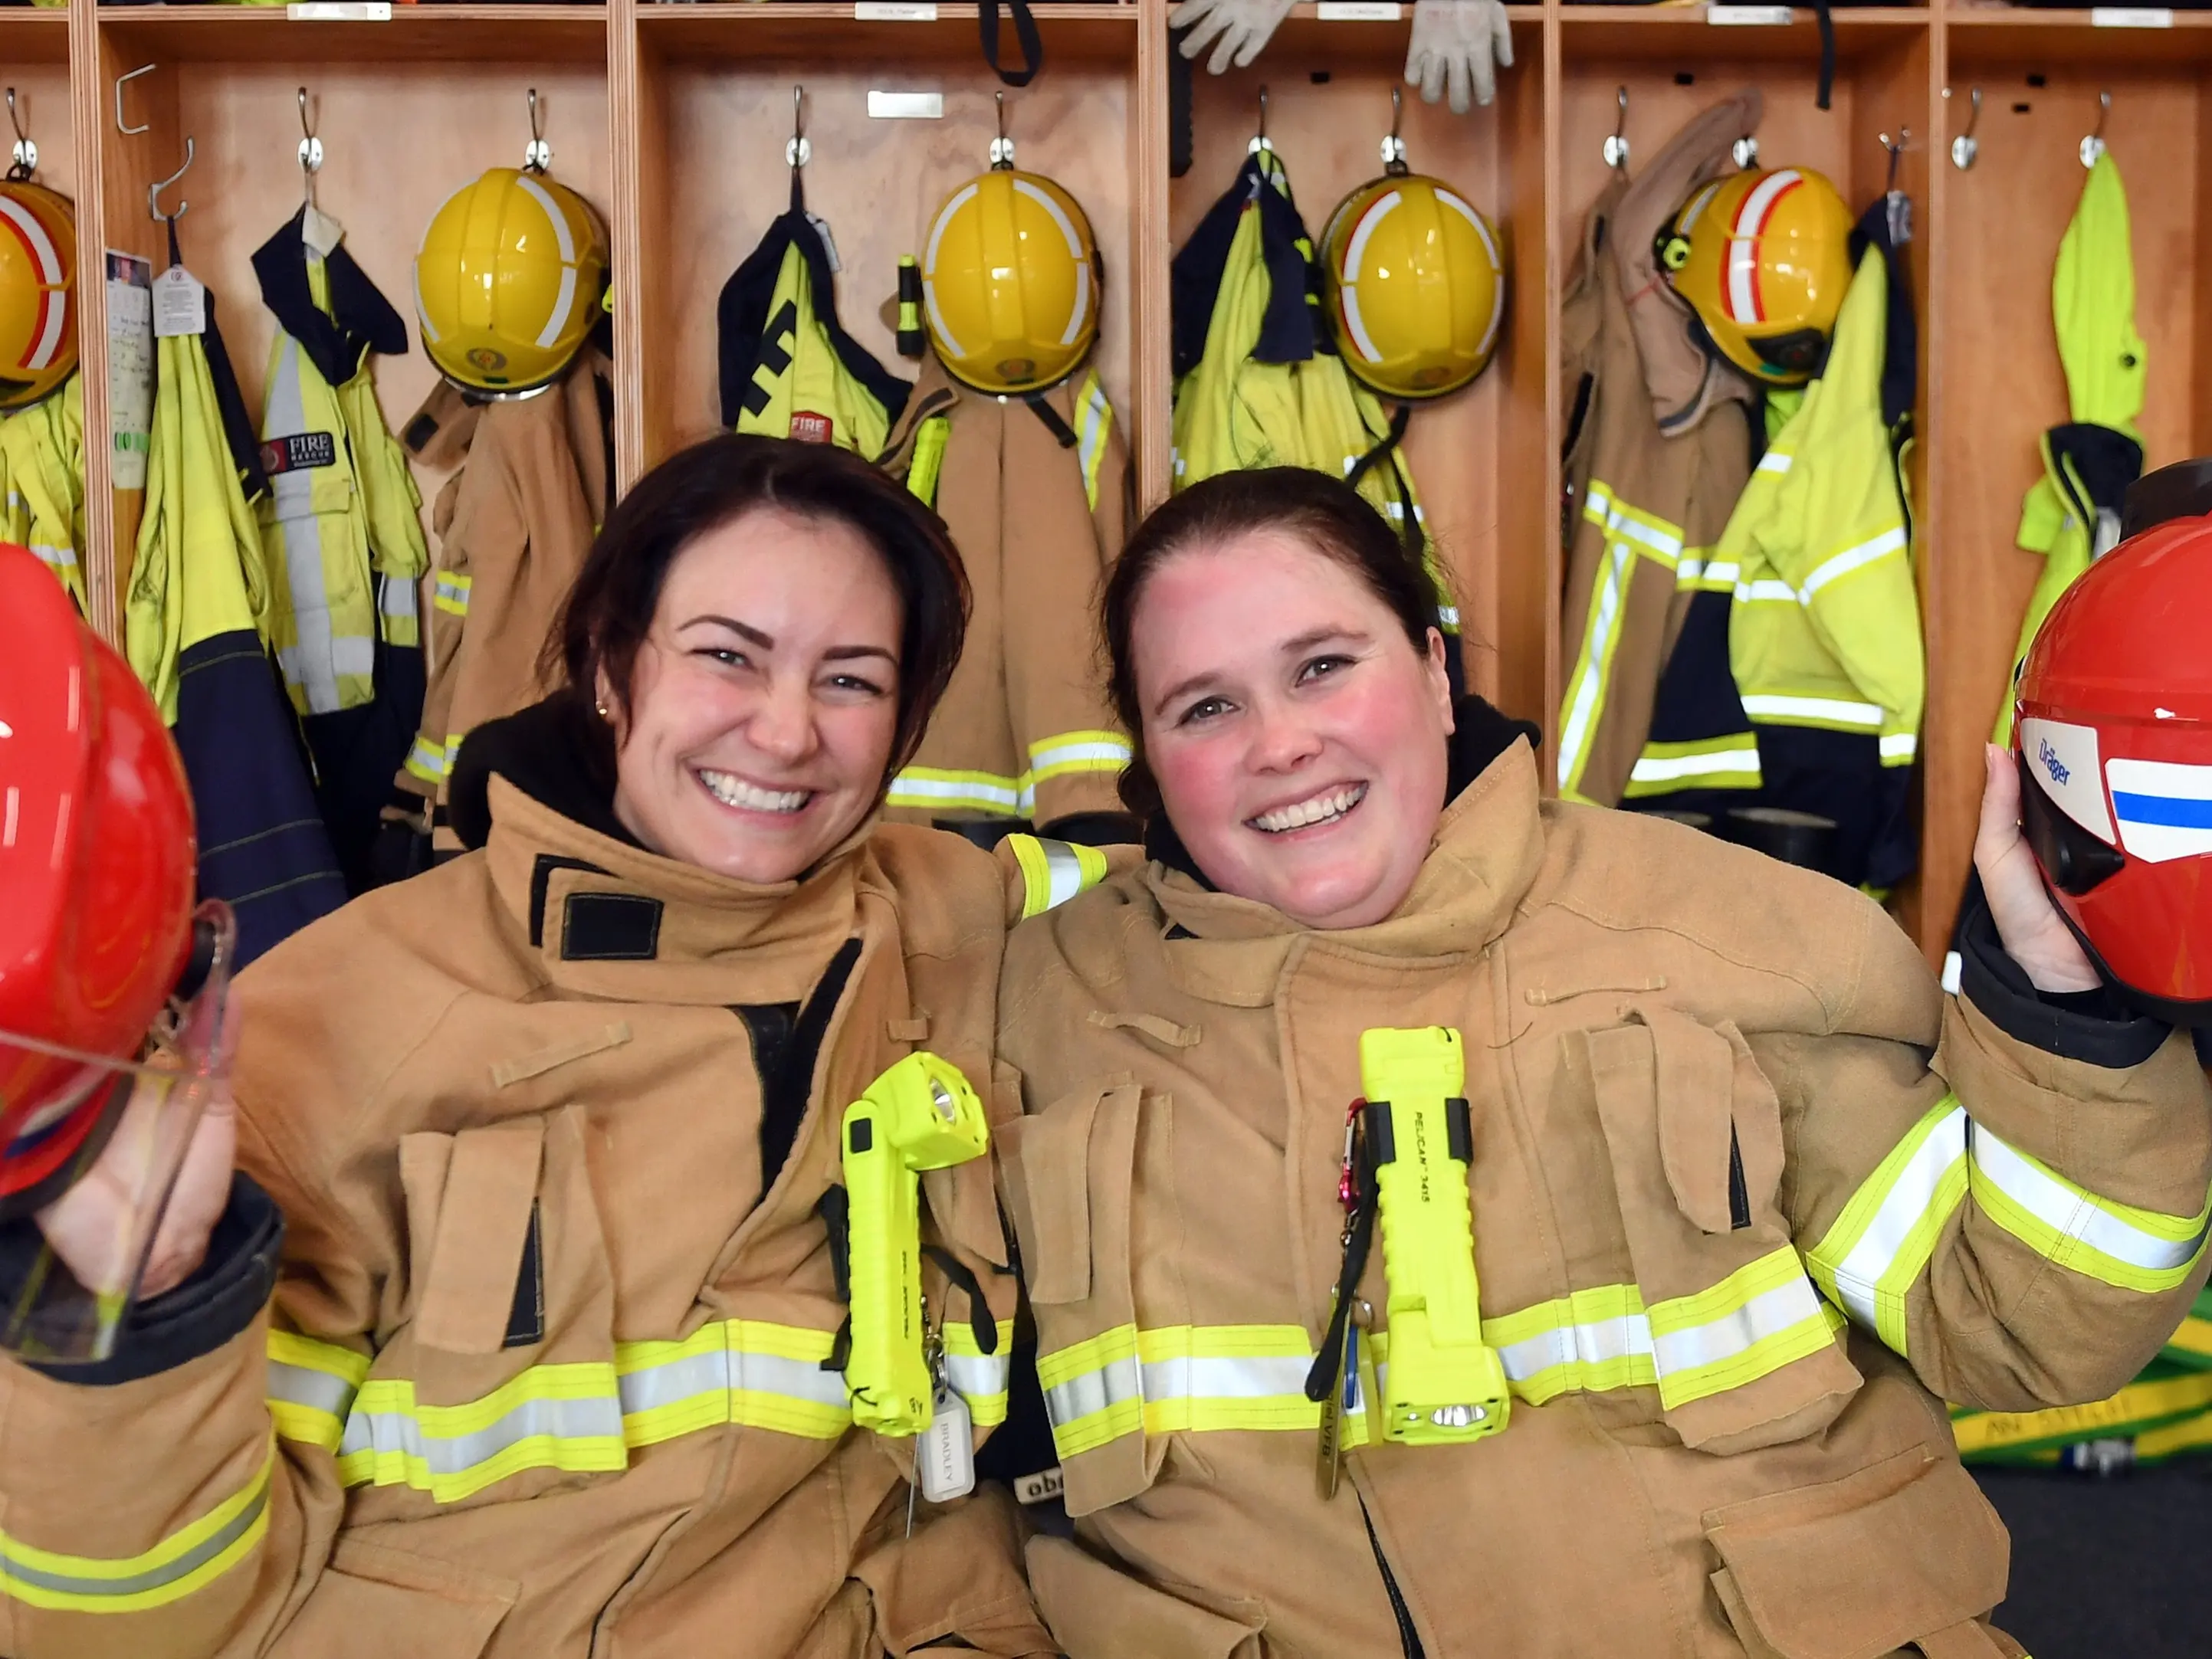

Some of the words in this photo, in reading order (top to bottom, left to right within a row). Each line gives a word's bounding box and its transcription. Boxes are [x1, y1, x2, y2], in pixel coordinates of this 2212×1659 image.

[791, 416, 825, 432] FIRE
[290, 434, 330, 453] FIRE
[2039, 738, 2071, 786] Dräger
[940, 1422, 953, 1481] BRADLEY
